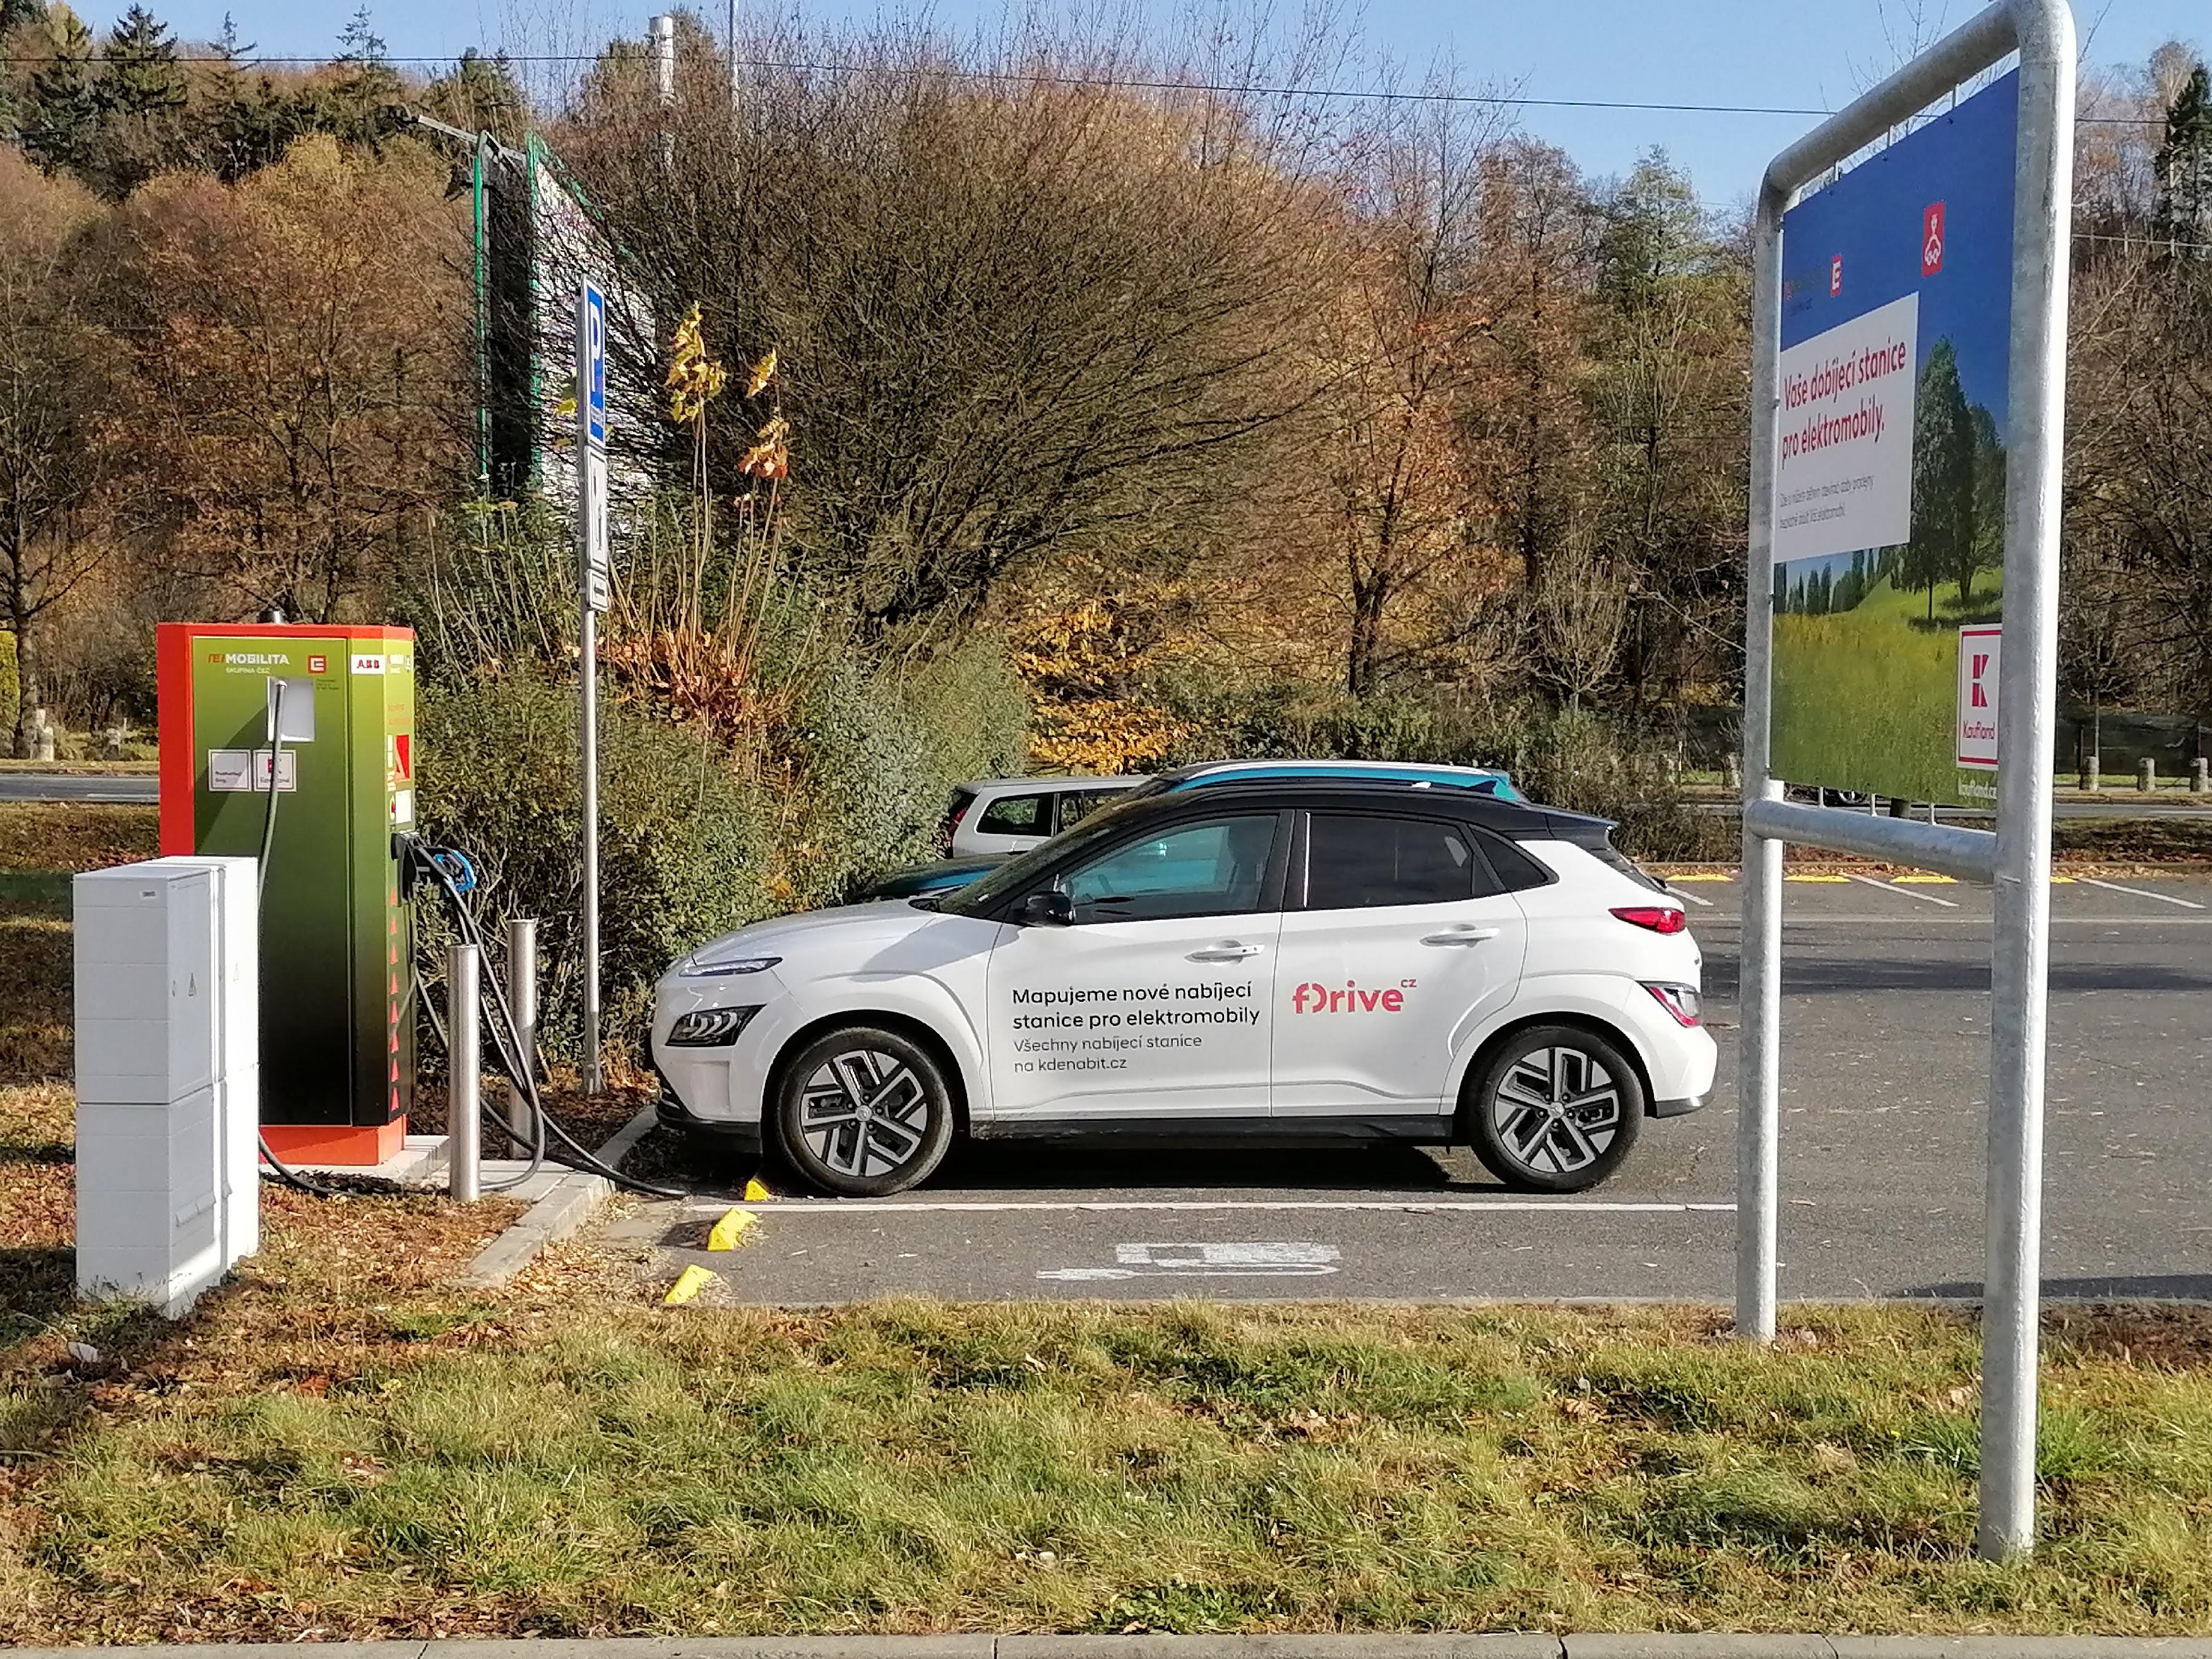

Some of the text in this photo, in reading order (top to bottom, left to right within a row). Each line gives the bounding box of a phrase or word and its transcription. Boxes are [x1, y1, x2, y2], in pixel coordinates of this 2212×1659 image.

[590, 301, 601, 392] P
[1785, 336, 1906, 411] Vaše dobíjecí stanice
[1782, 394, 1884, 470] pro elektromobily.
[357, 659, 380, 669] ABB
[1971, 654, 1989, 707] K
[1963, 720, 1995, 739] Kaufland
[1013, 981, 1252, 1006] Mapujeme nové nabíjecí
[1013, 1007, 1261, 1030] stanice pro elektromobily
[1013, 1033, 1203, 1053] Všechny nabíjecí stanice
[1014, 1057, 1127, 1073] na kdenabit.cz
